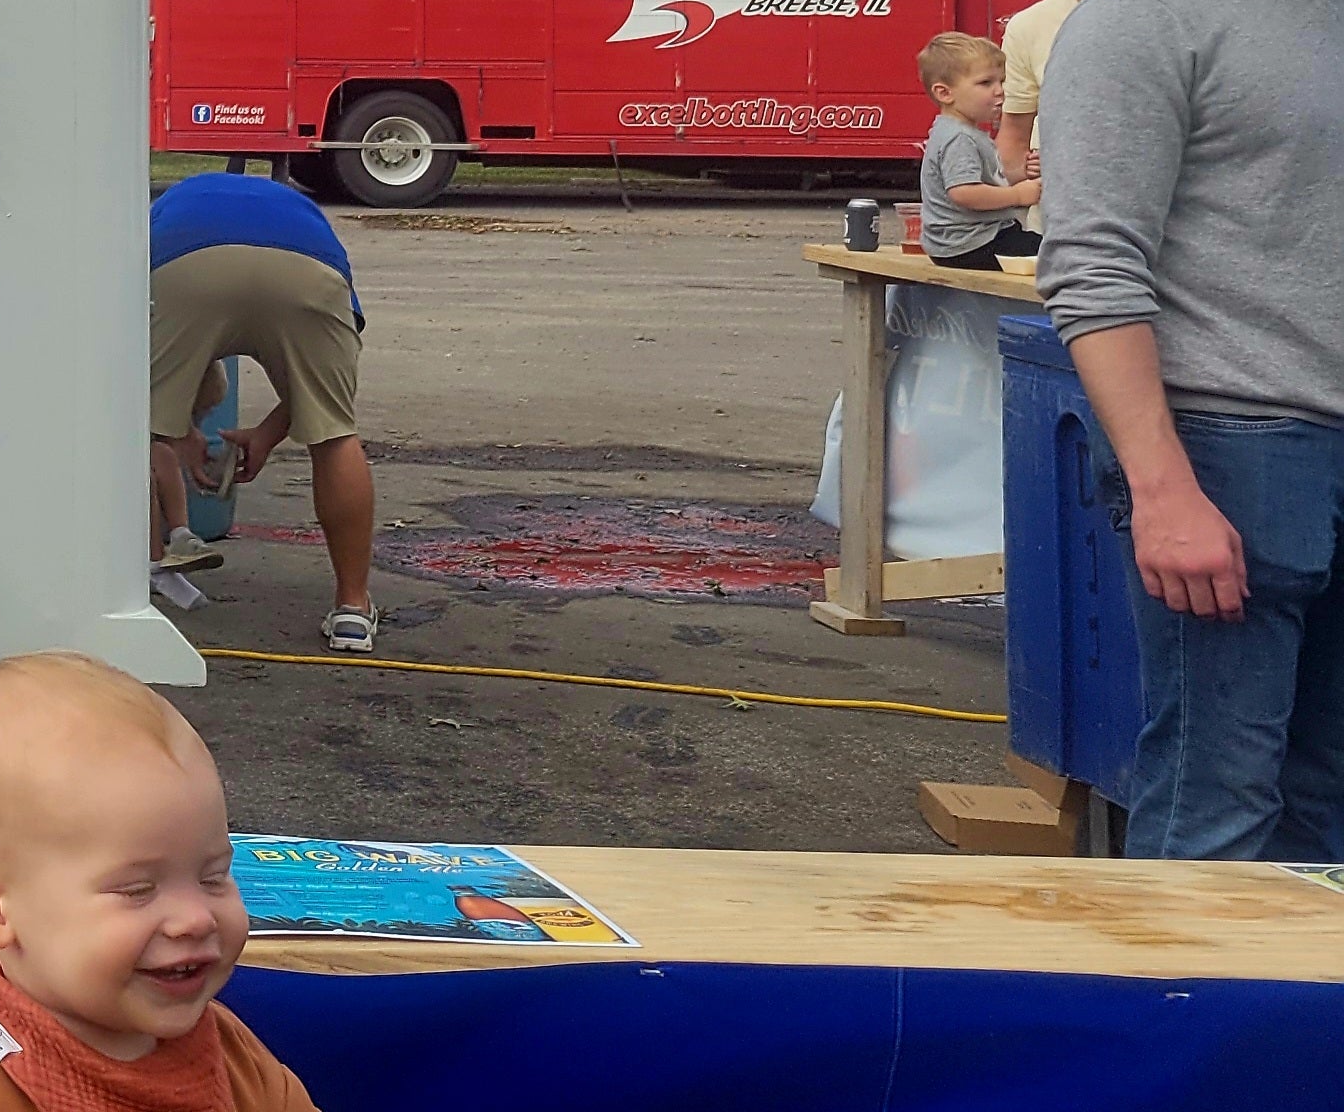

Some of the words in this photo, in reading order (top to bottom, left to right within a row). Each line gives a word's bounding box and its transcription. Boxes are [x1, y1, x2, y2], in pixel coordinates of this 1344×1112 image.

[215, 104, 237, 114] Find
[214, 115, 265, 124] Facebook!
[619, 98, 883, 135] excelbottling.com
[251, 849, 341, 862] BIG
[315, 861, 404, 872] Golden
